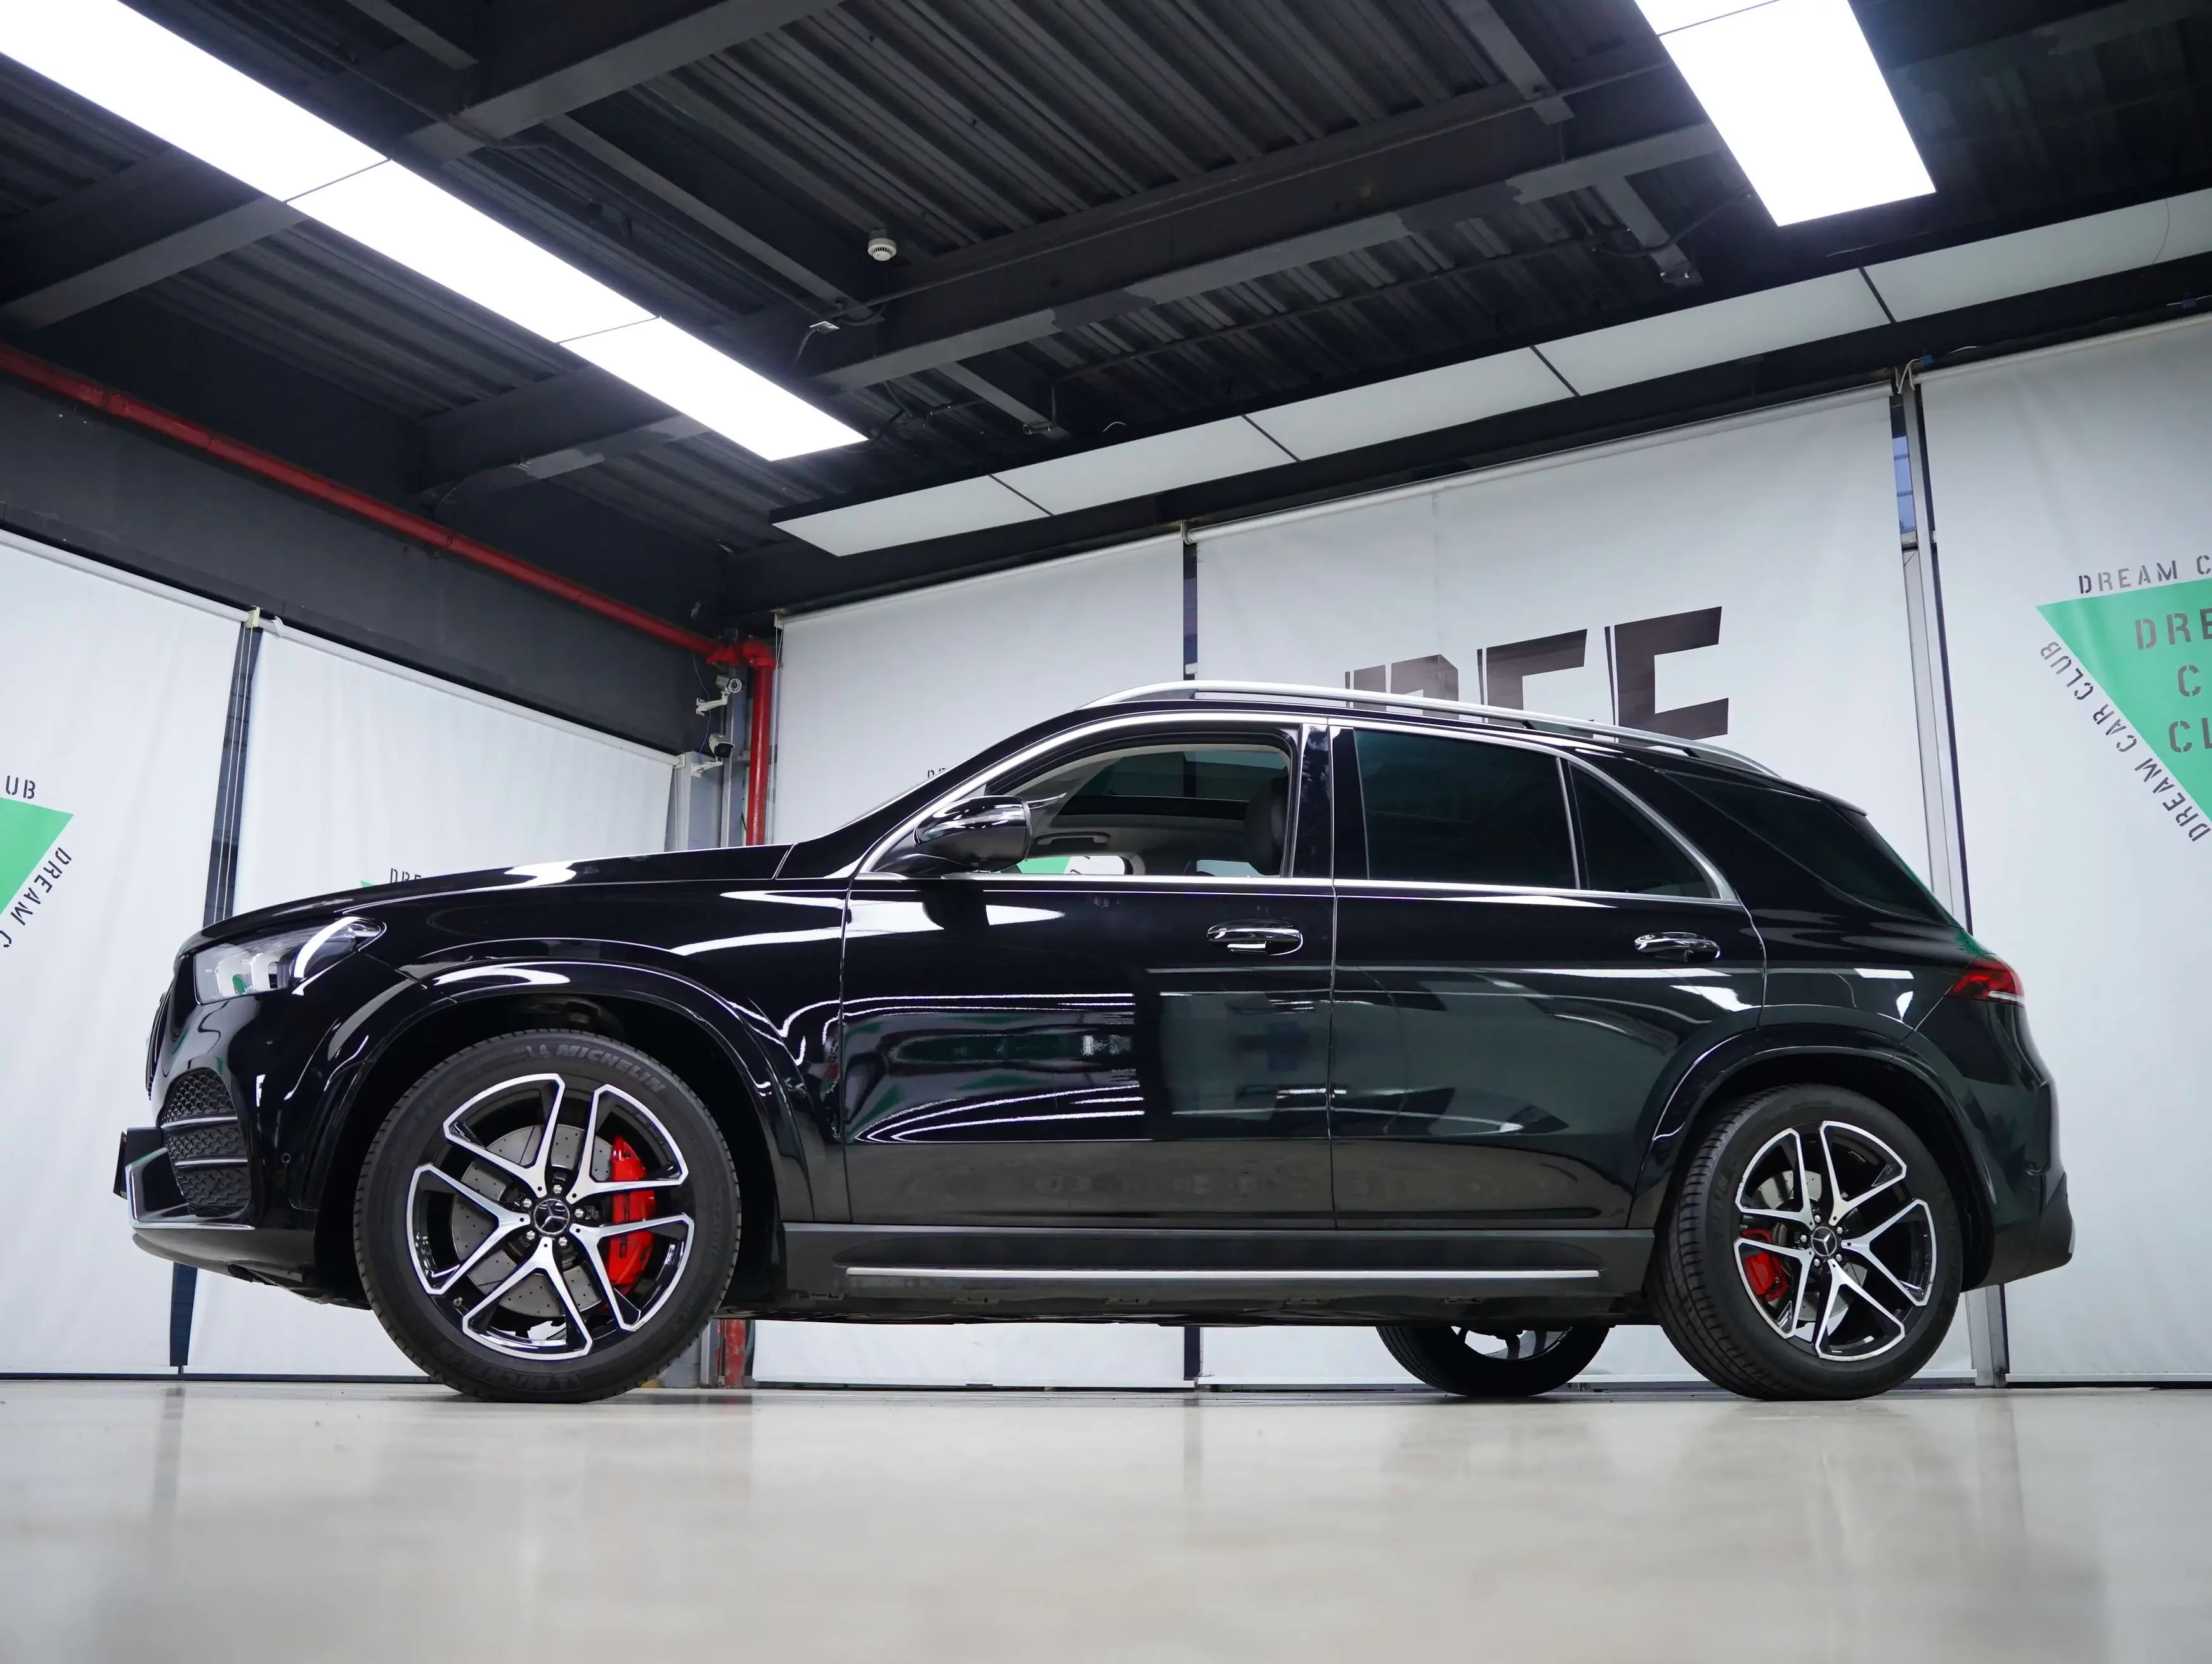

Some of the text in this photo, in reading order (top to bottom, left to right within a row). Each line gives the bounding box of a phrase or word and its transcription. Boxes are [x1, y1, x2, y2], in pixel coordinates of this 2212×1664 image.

[2078, 555, 2212, 594] DREAM C
[2177, 665, 2202, 697] C
[2040, 641, 2212, 842] DREAM CAR CLUB
[6, 776, 36, 799] UB
[10, 847, 72, 926] DREAM
[556, 1044, 667, 1093] MICHELIN
